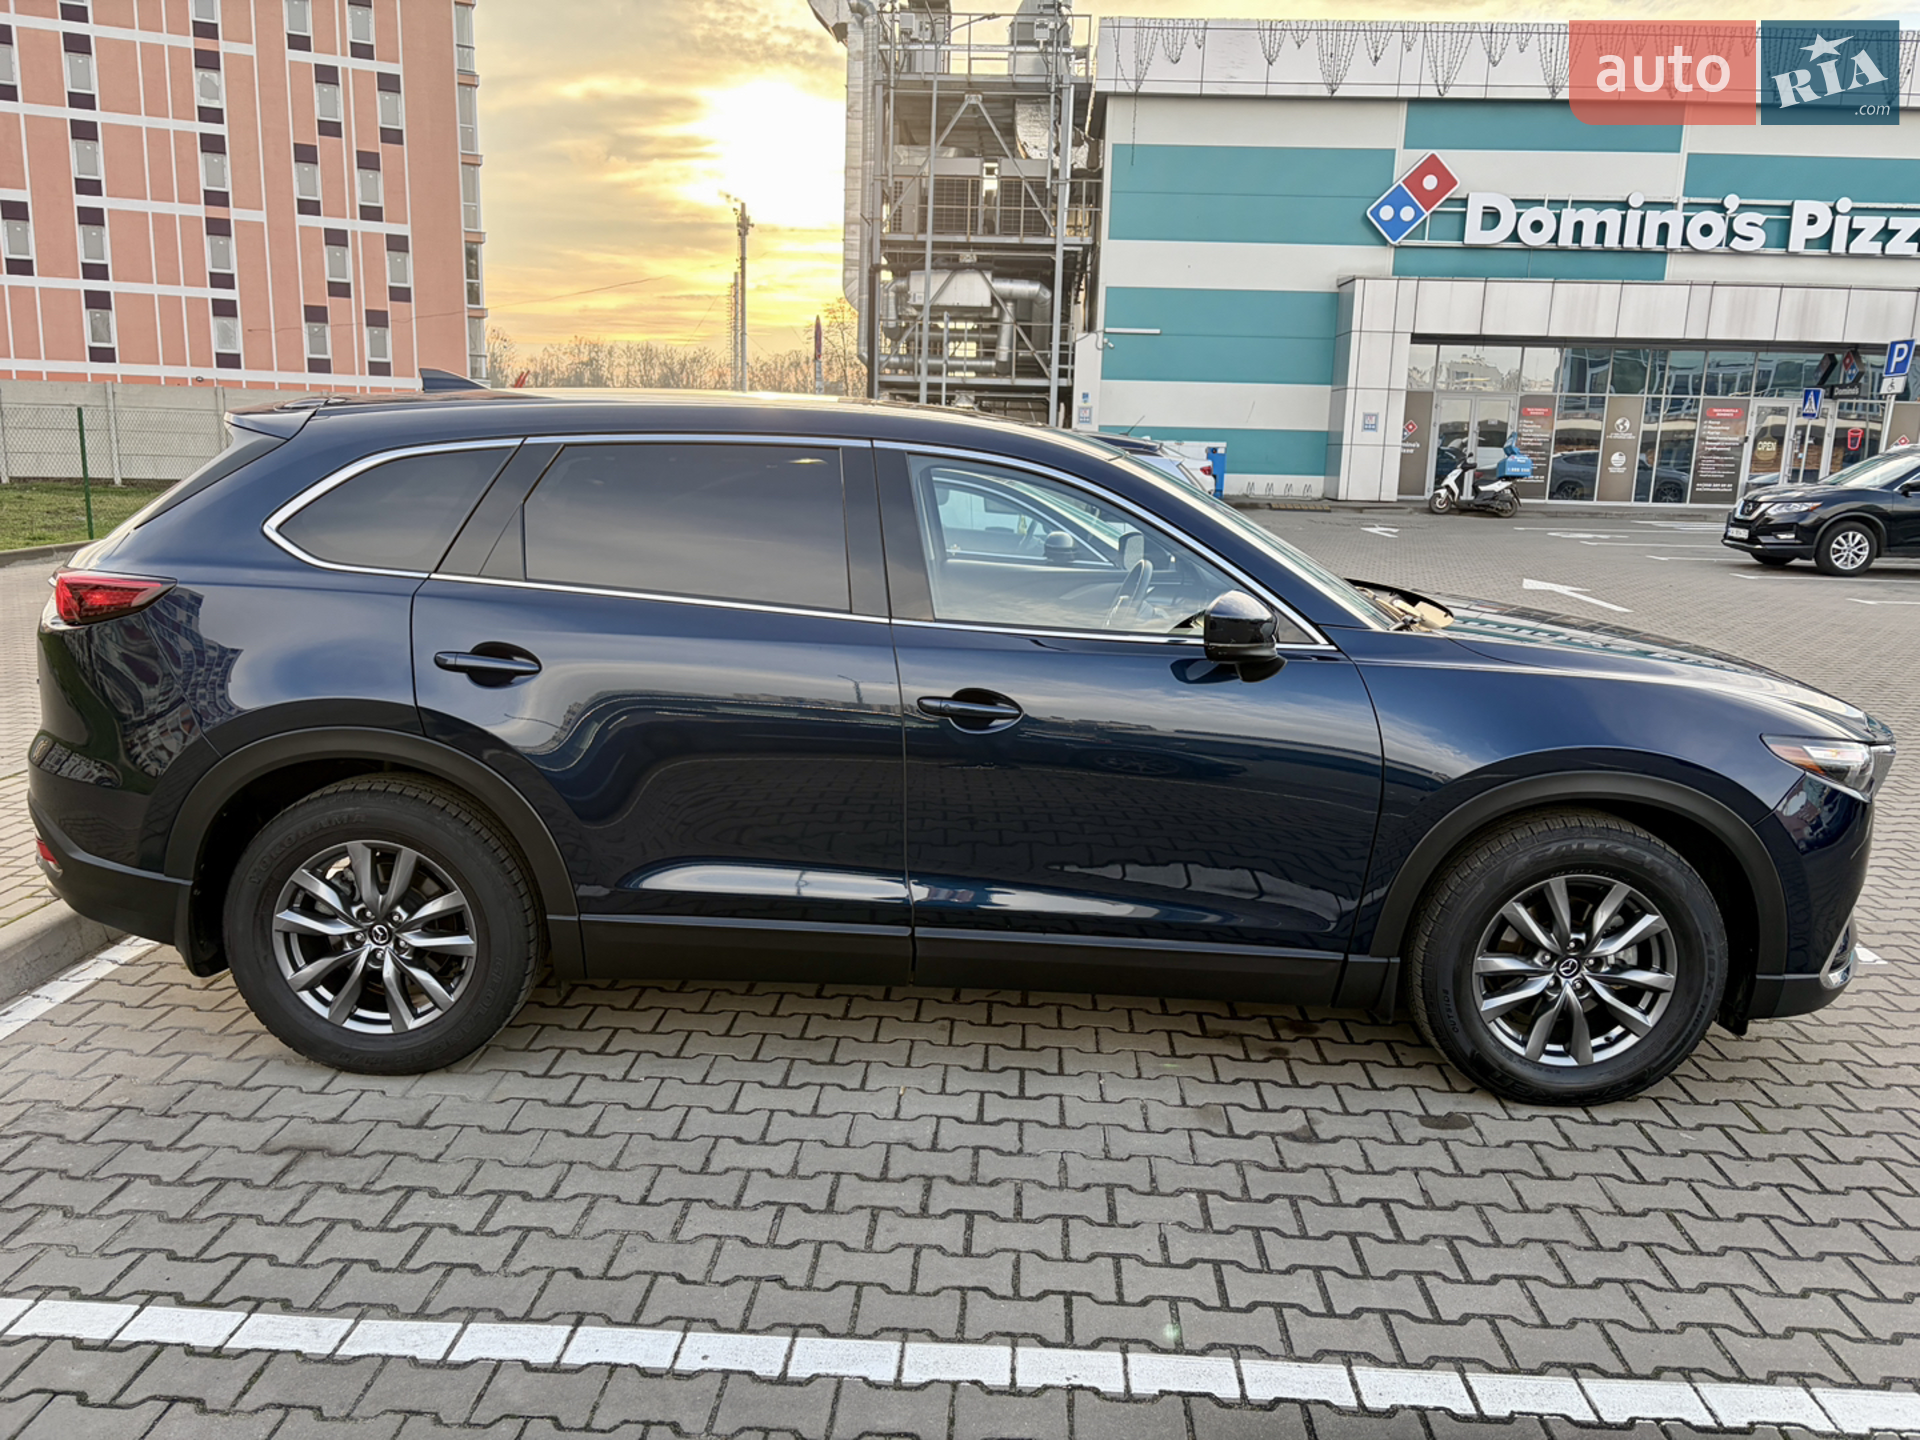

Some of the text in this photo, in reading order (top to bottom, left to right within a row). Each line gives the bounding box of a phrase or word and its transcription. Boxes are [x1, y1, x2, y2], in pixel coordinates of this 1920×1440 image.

[1463, 191, 1920, 254] Domino's Pizz
[1895, 344, 1909, 372] P
[1757, 441, 1777, 452] OPEN
[248, 812, 367, 885] YOKOHAMA
[396, 956, 505, 1067] GEOLANDAR
[1442, 988, 1459, 1034] OUTSIDE
